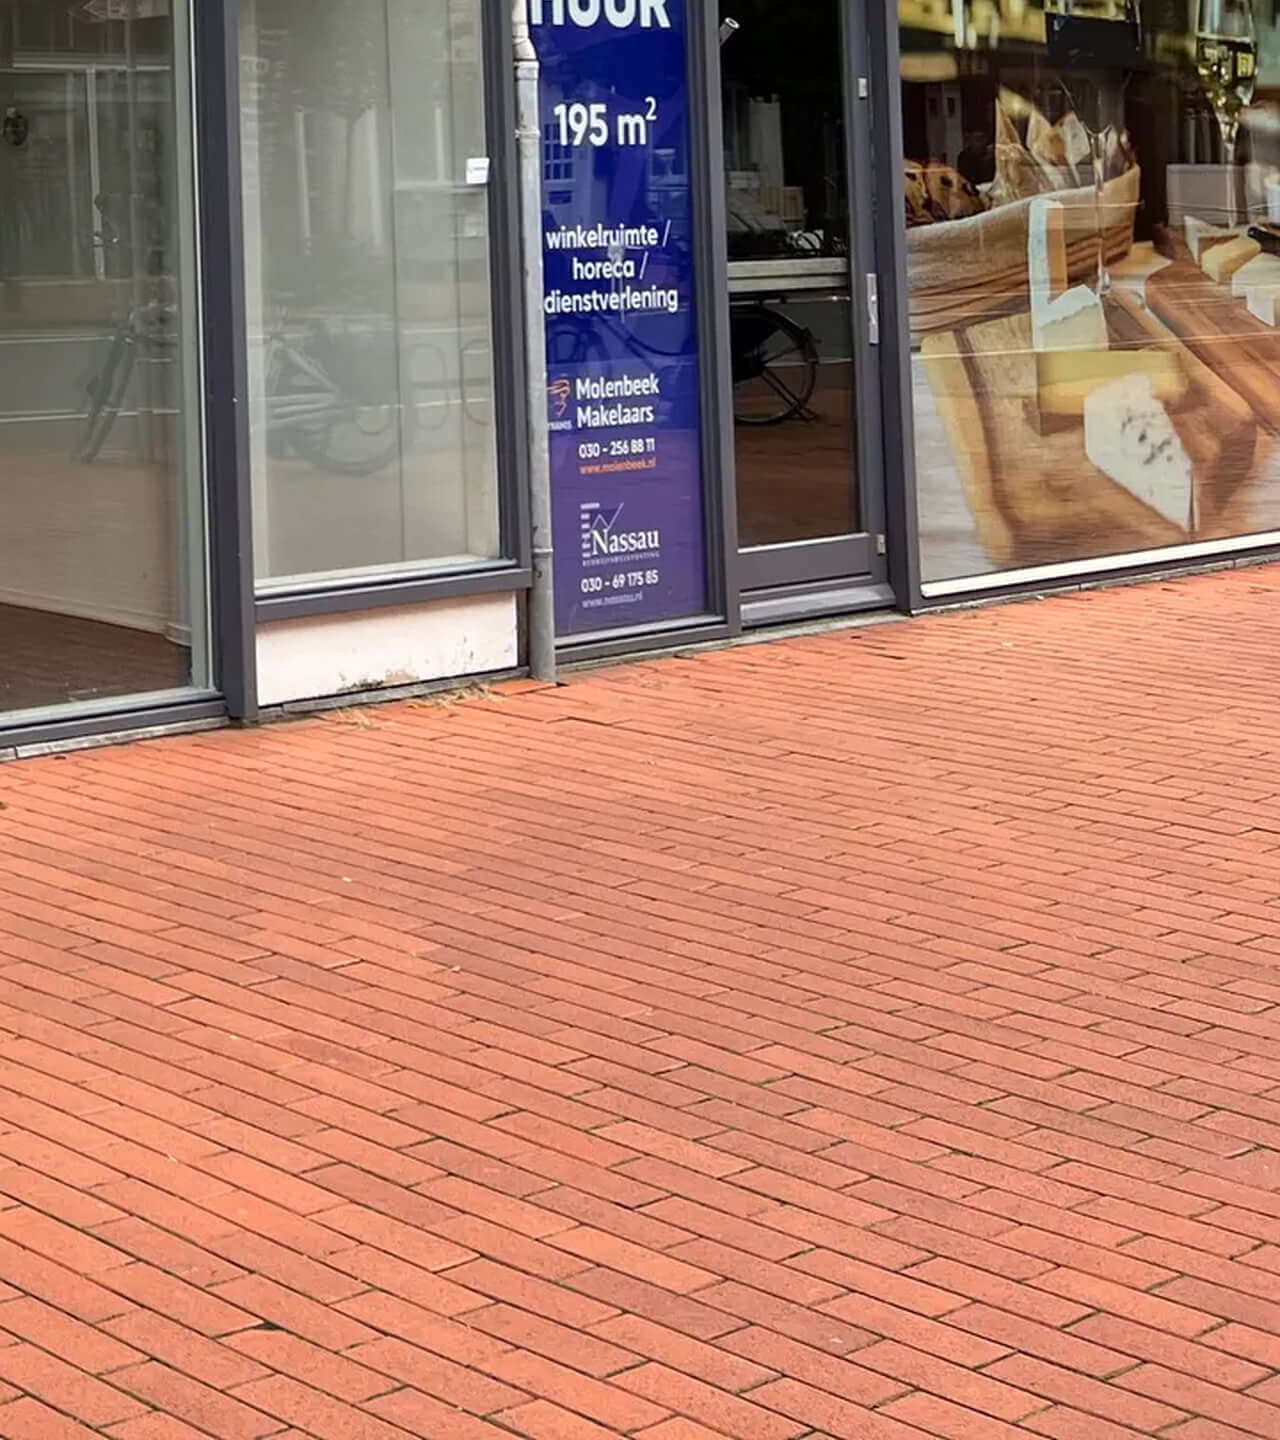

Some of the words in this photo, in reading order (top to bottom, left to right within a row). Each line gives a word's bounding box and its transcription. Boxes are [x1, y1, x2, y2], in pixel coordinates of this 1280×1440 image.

[554, 103, 608, 147] 195
[546, 223, 659, 249] winkelruimte
[572, 257, 635, 280] horeca
[543, 284, 678, 313] dienstverlening
[576, 372, 660, 400] Molenbeek
[577, 403, 655, 428] Makelaars
[578, 442, 600, 459] 030
[609, 440, 629, 456] 256
[630, 438, 645, 454] 88
[645, 437, 656, 452] 11
[591, 528, 660, 555] Nassau
[580, 576, 603, 593] 030
[612, 573, 626, 589] 69
[626, 570, 644, 587] 175
[645, 569, 659, 585] 85
